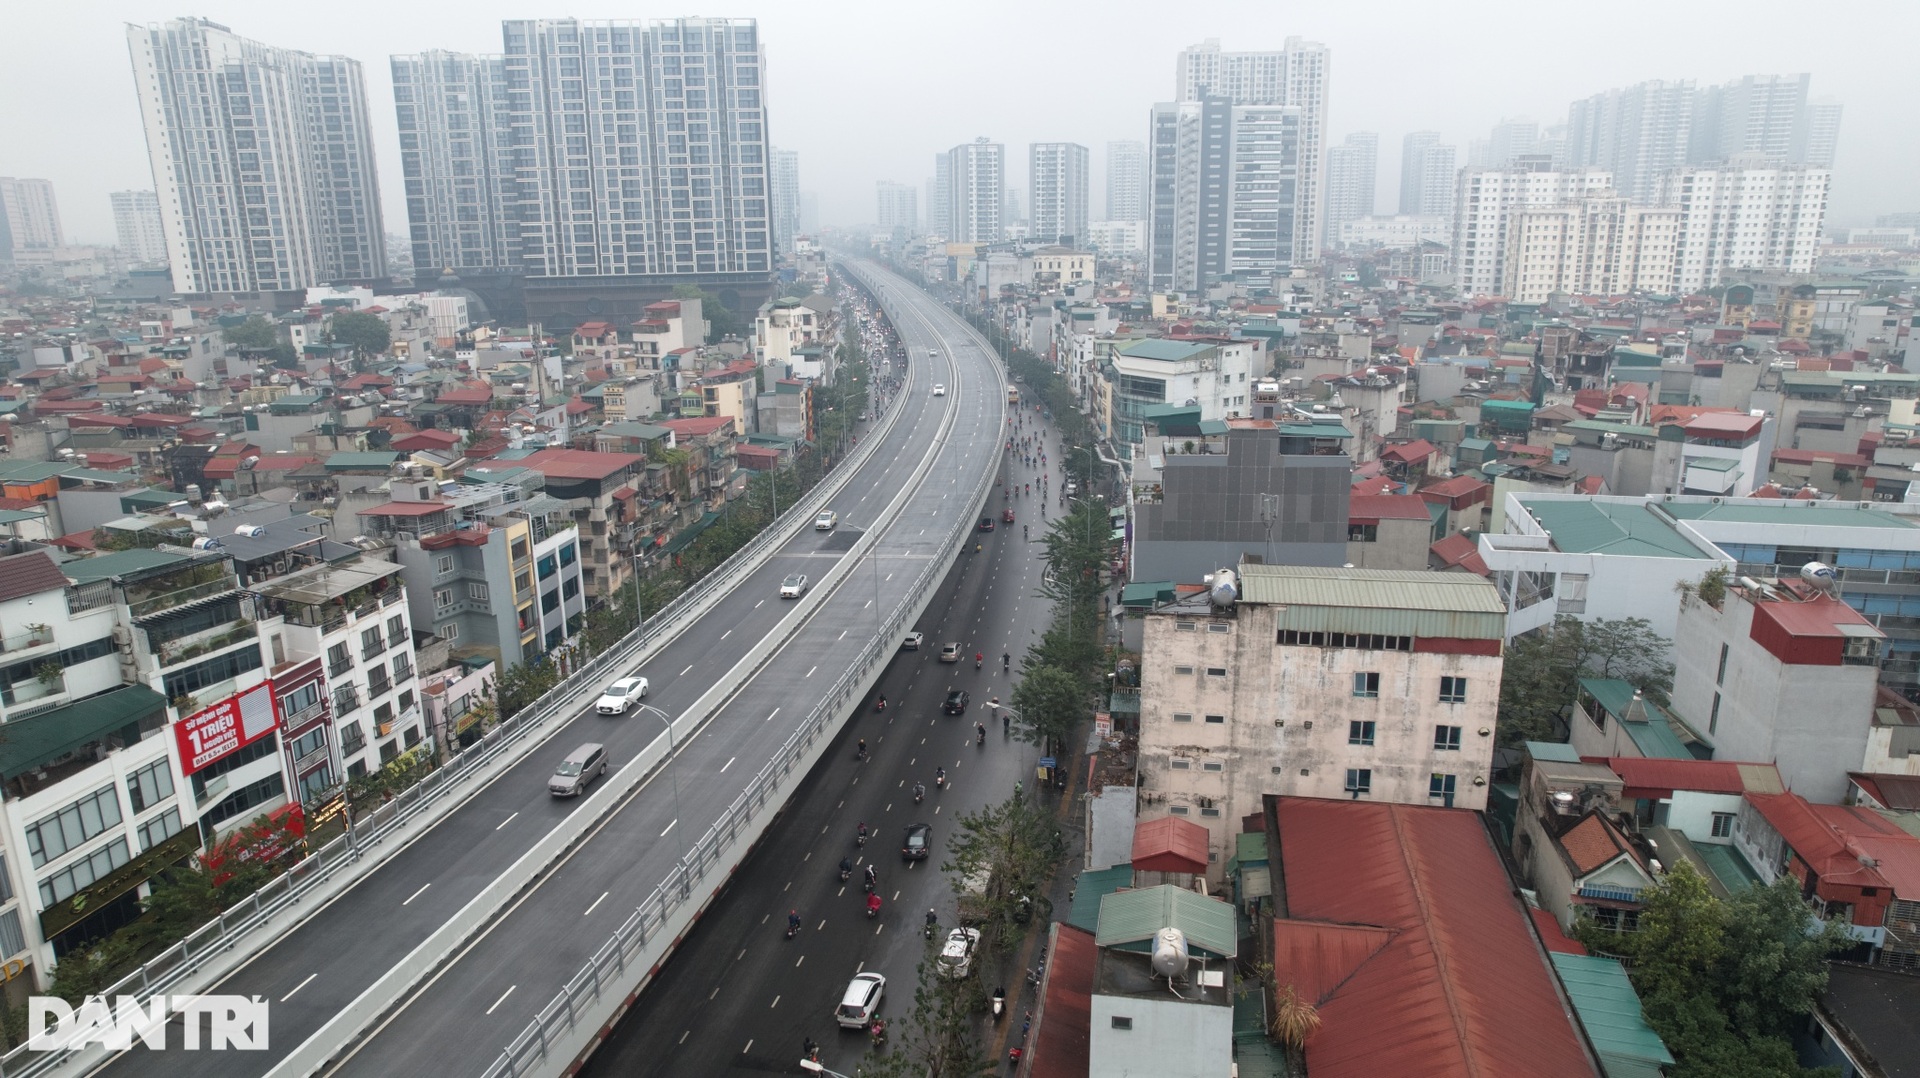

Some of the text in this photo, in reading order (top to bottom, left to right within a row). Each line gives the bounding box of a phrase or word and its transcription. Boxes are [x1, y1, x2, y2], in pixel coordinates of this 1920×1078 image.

[188, 713, 234, 755] 1 TRIỆU
[223, 728, 237, 741] VIỆT
[221, 741, 237, 751] IELTS
